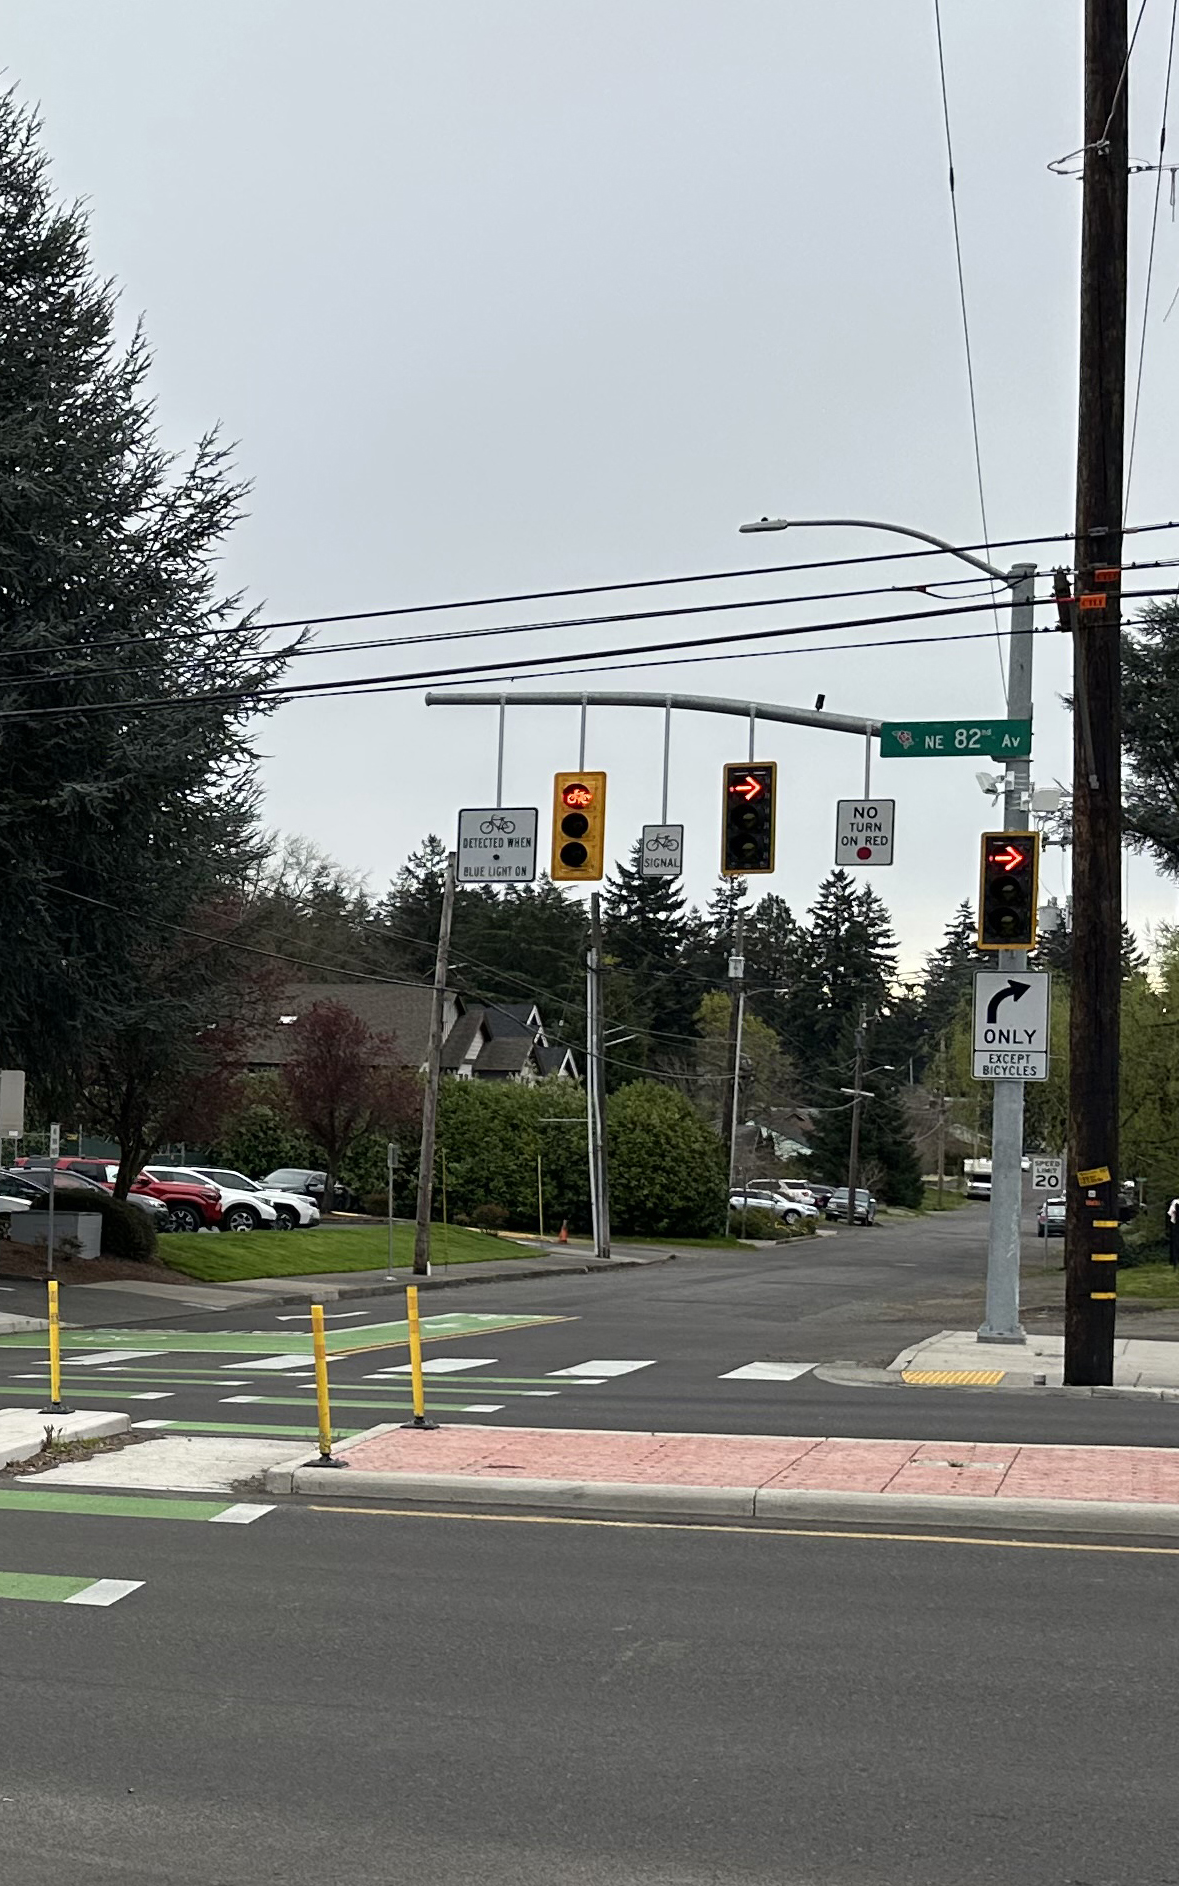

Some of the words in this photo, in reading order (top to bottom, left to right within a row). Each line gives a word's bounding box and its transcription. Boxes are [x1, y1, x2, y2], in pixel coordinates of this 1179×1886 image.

[925, 735, 944, 749] NE
[1001, 734, 1021, 748] Av
[853, 806, 878, 819] NO
[849, 822, 882, 832] TURN
[462, 837, 504, 848] DETECTED
[507, 836, 532, 848] WHEN
[841, 835, 858, 846] ON
[864, 835, 888, 846] RED
[643, 857, 680, 868] SIGNAL
[463, 866, 487, 877] BLUE
[488, 866, 513, 877] LIGHT
[515, 865, 527, 876] ON
[984, 1028, 1037, 1044] ONLY
[989, 1053, 1031, 1064] EXCEPT
[982, 1064, 1037, 1076] BICYCLES
[1035, 1174, 1059, 1188] 20
